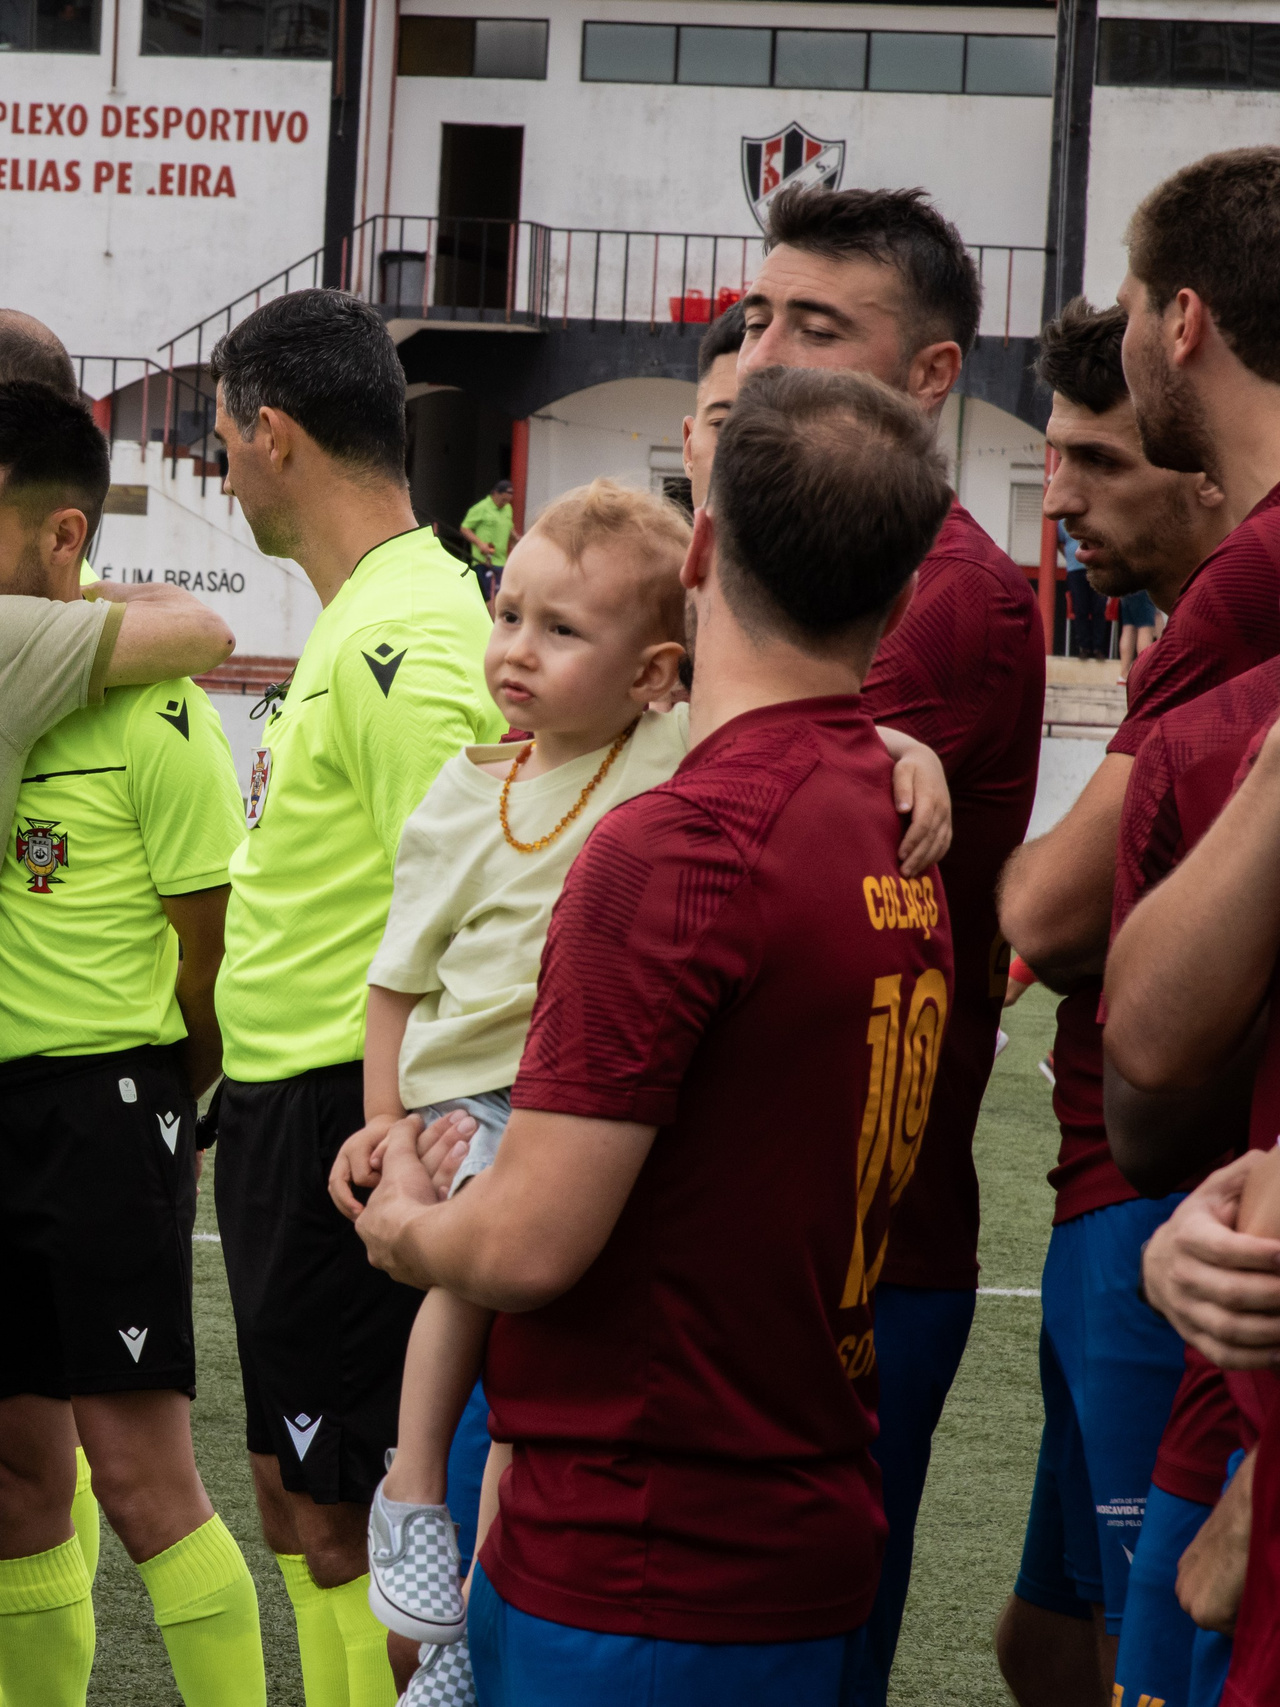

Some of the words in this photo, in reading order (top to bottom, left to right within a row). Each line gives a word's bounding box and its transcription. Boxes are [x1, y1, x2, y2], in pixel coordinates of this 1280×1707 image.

[100, 105, 309, 144] DESPORTIVO
[93, 161, 237, 198] PEEIRA
[164, 568, 246, 593] BRASÃO
[862, 875, 939, 940] COLAÇO
